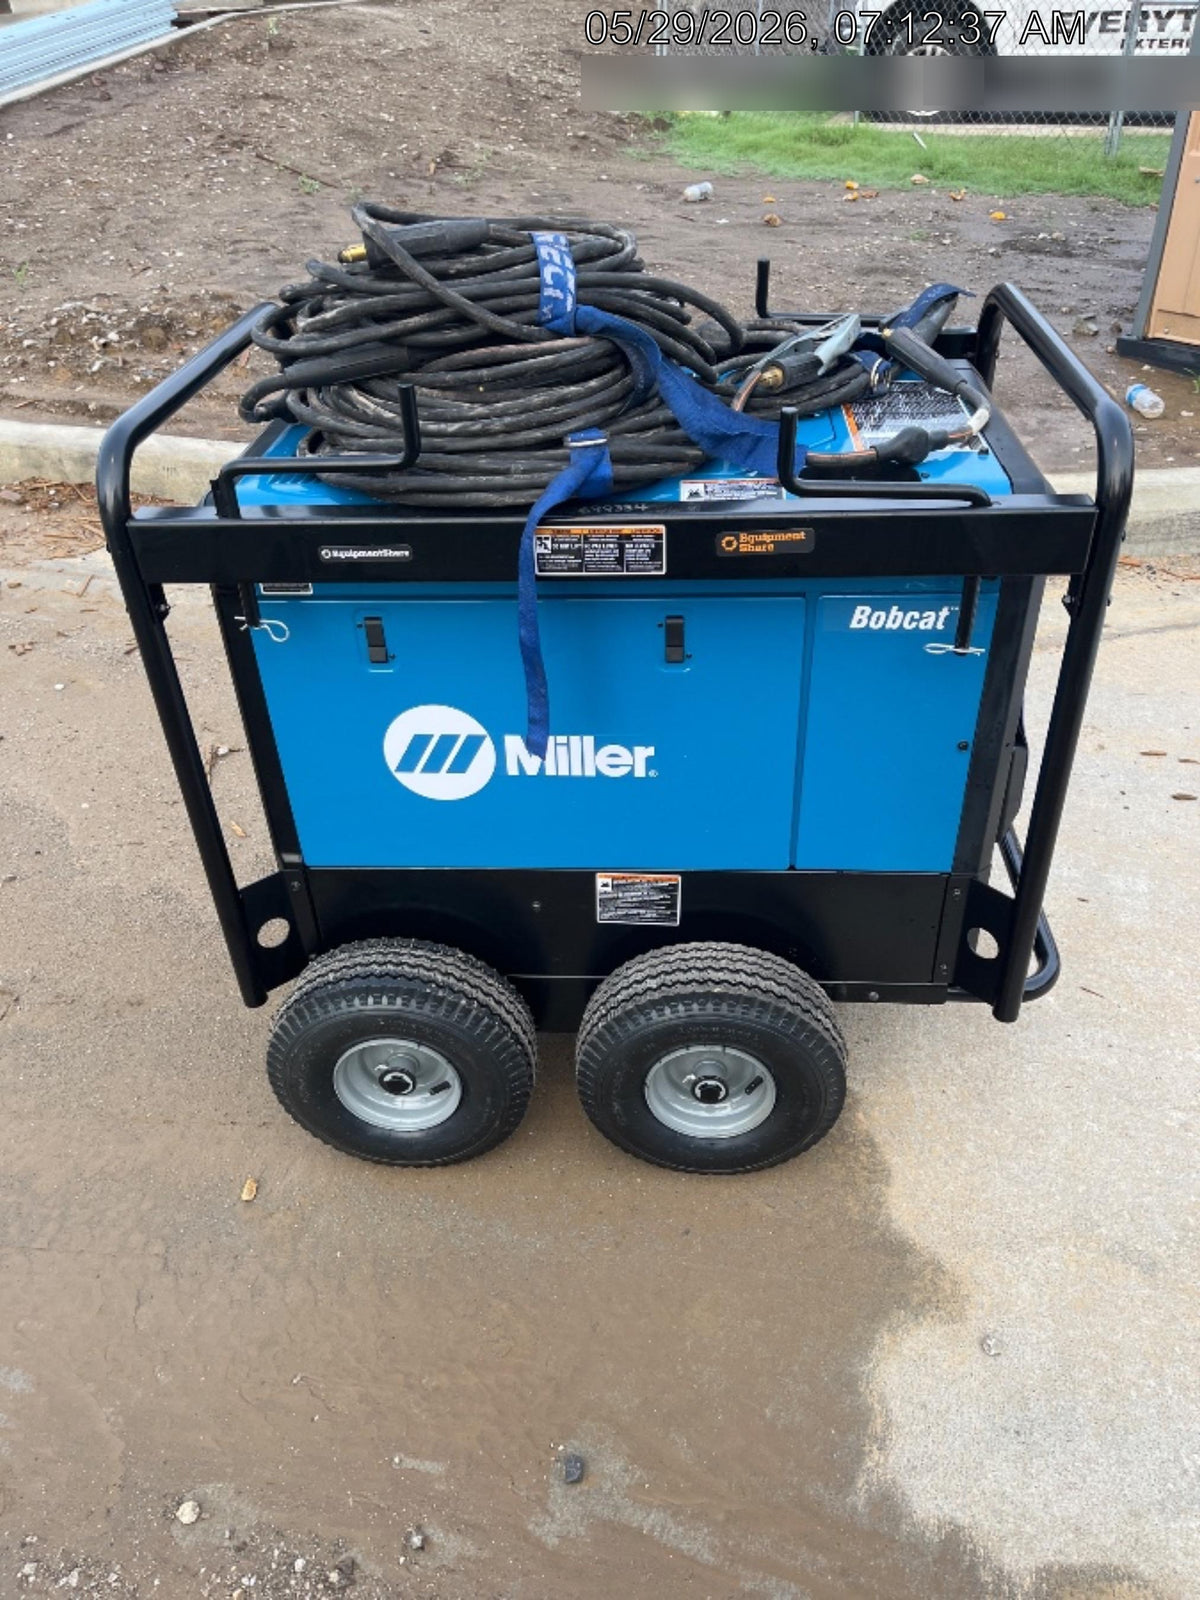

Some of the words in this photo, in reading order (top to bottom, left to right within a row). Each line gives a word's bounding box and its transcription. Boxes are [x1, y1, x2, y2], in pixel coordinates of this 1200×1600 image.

[739, 531, 806, 544] Equipment
[739, 543, 775, 552] Share
[849, 605, 951, 630] Bobcat
